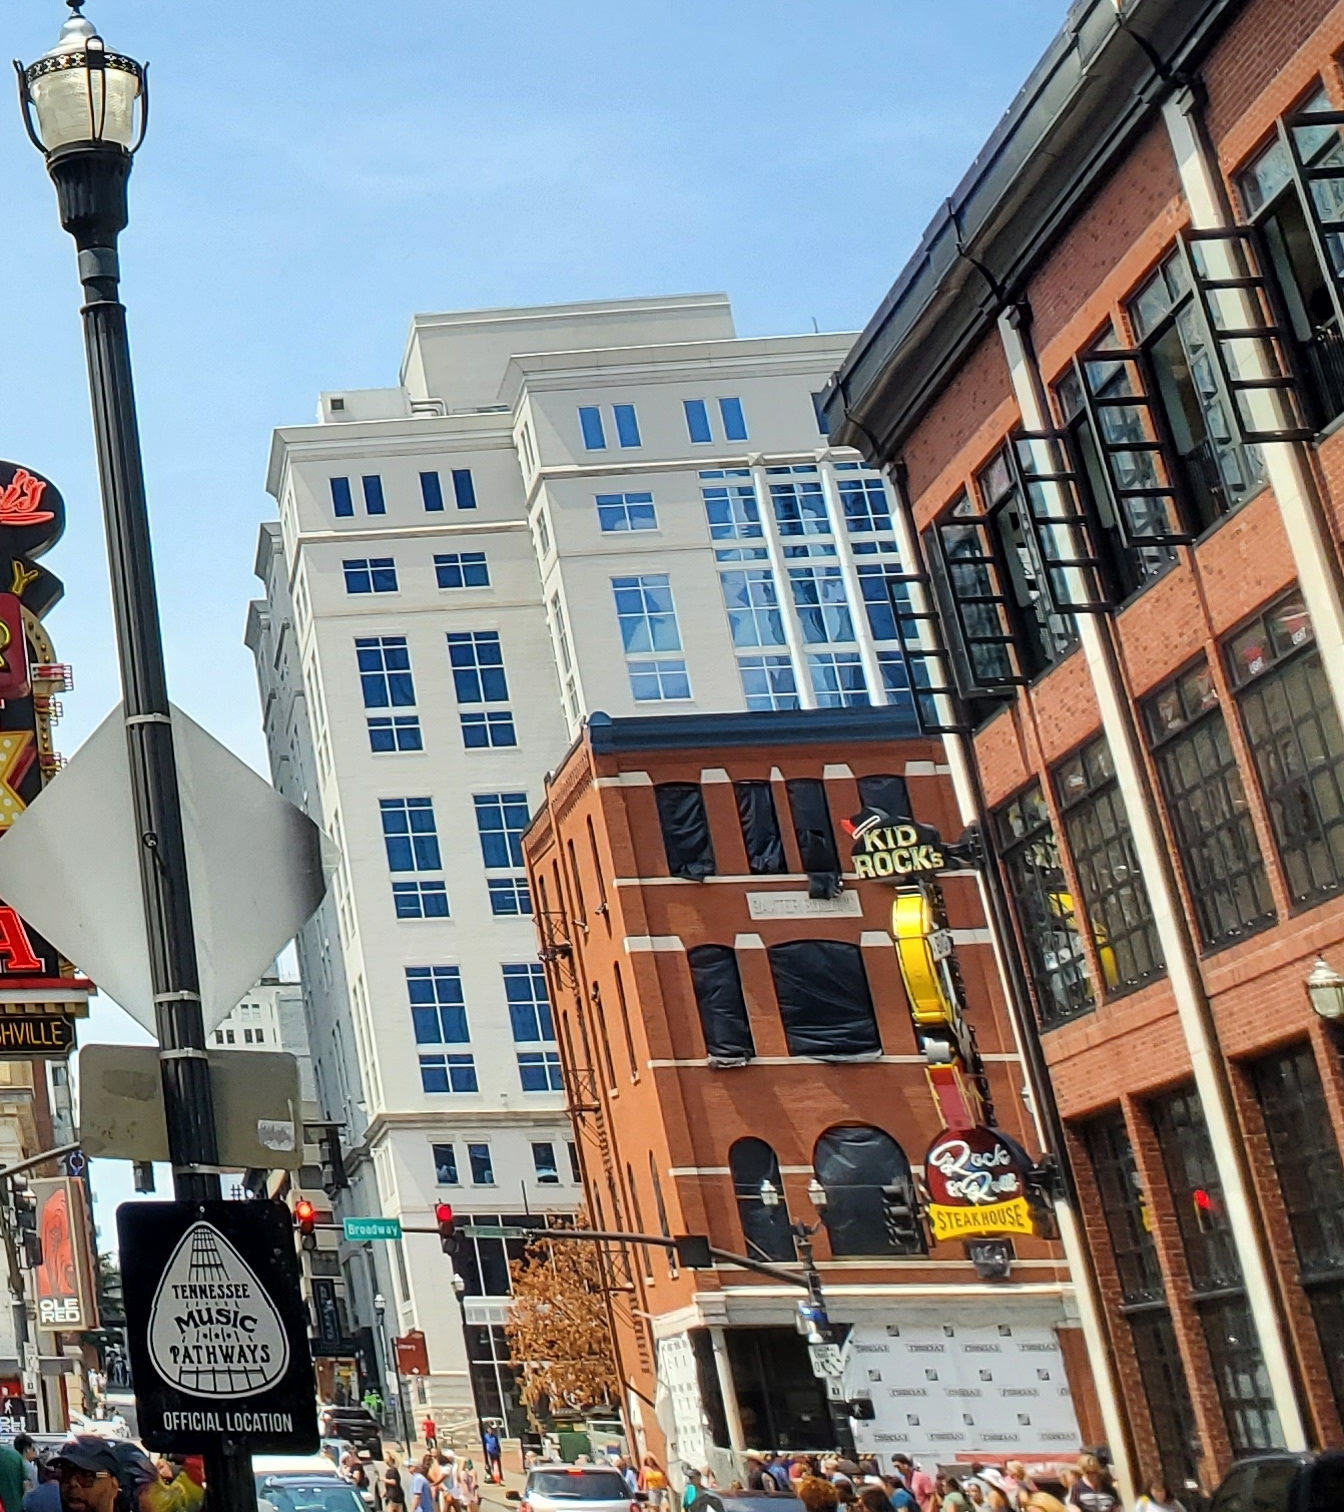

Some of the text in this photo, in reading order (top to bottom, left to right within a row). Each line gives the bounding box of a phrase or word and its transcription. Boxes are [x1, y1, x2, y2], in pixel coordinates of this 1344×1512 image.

[863, 825, 918, 852] KID
[929, 1140, 1011, 1176] Rock
[937, 1204, 1024, 1231] STEAKHOUSE
[348, 1224, 398, 1236] Broadway
[172, 1283, 250, 1299] TENNESSEE
[40, 1297, 79, 1311] OLE
[42, 1310, 80, 1323] RED
[174, 1307, 258, 1334] MUSIC
[169, 1344, 270, 1364] PATHWAYS
[163, 1411, 293, 1432] OFFICIAL LOCATION
